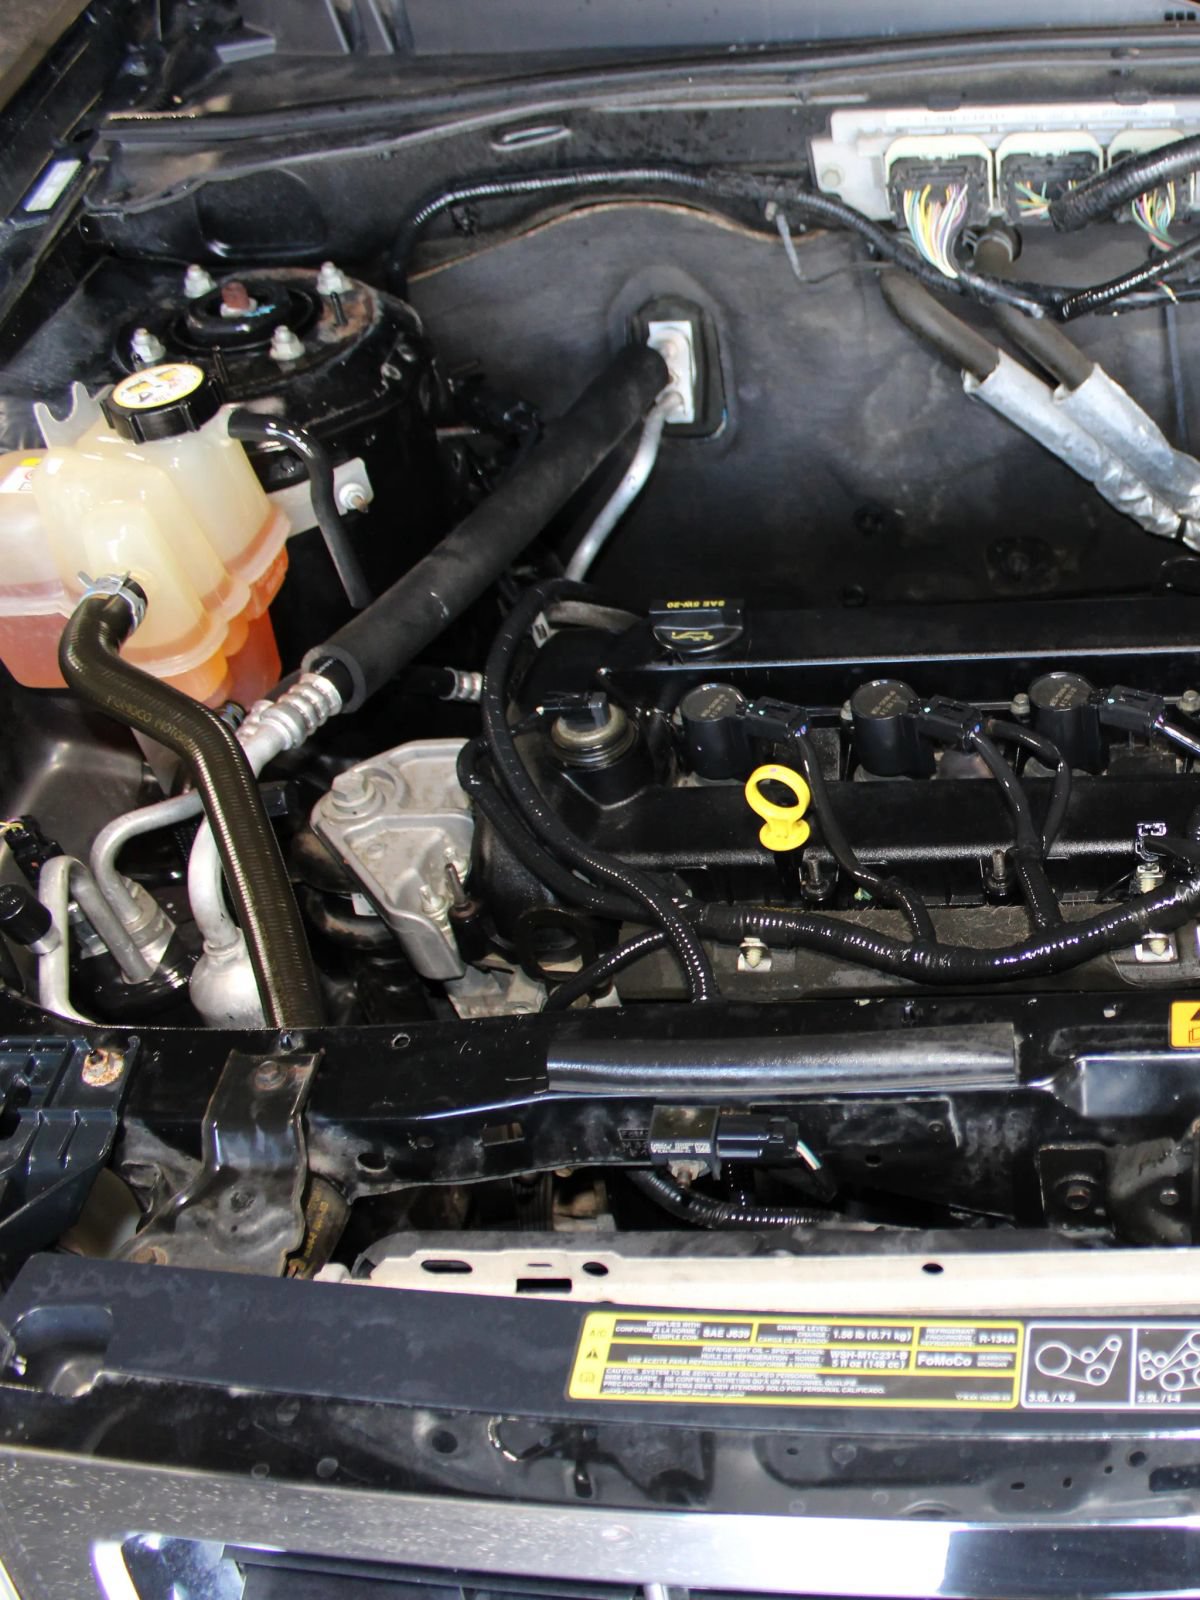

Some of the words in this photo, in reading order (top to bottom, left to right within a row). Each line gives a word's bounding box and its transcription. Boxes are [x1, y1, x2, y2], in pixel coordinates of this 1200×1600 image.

[666, 600, 700, 609] 5W-20
[703, 600, 725, 608] SAE
[702, 1326, 725, 1339] SAE
[726, 1327, 750, 1339] J639
[855, 1327, 865, 1340] lb
[866, 1328, 892, 1341] (0.71
[893, 1328, 912, 1343] kg)
[979, 1331, 1016, 1344] R-134A
[832, 1359, 839, 1367] 5
[849, 1360, 862, 1368] oz
[917, 1353, 973, 1367] FoMoCo
